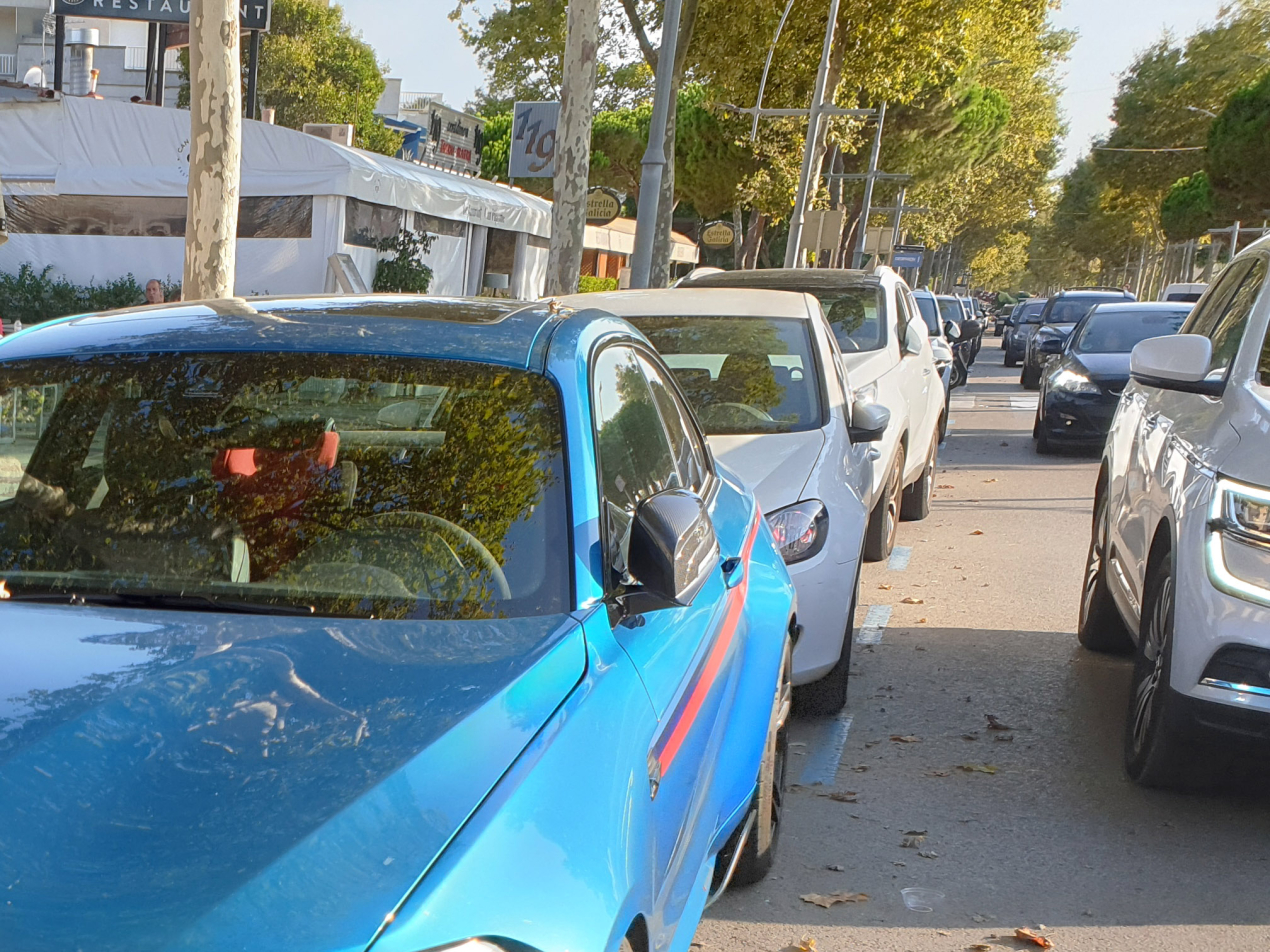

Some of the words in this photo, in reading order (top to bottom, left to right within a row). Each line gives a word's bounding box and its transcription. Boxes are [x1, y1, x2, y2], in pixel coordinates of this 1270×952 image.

[93, 0, 264, 19] RESTAUNT
[585, 199, 615, 209] strella
[586, 208, 612, 218] alicia
